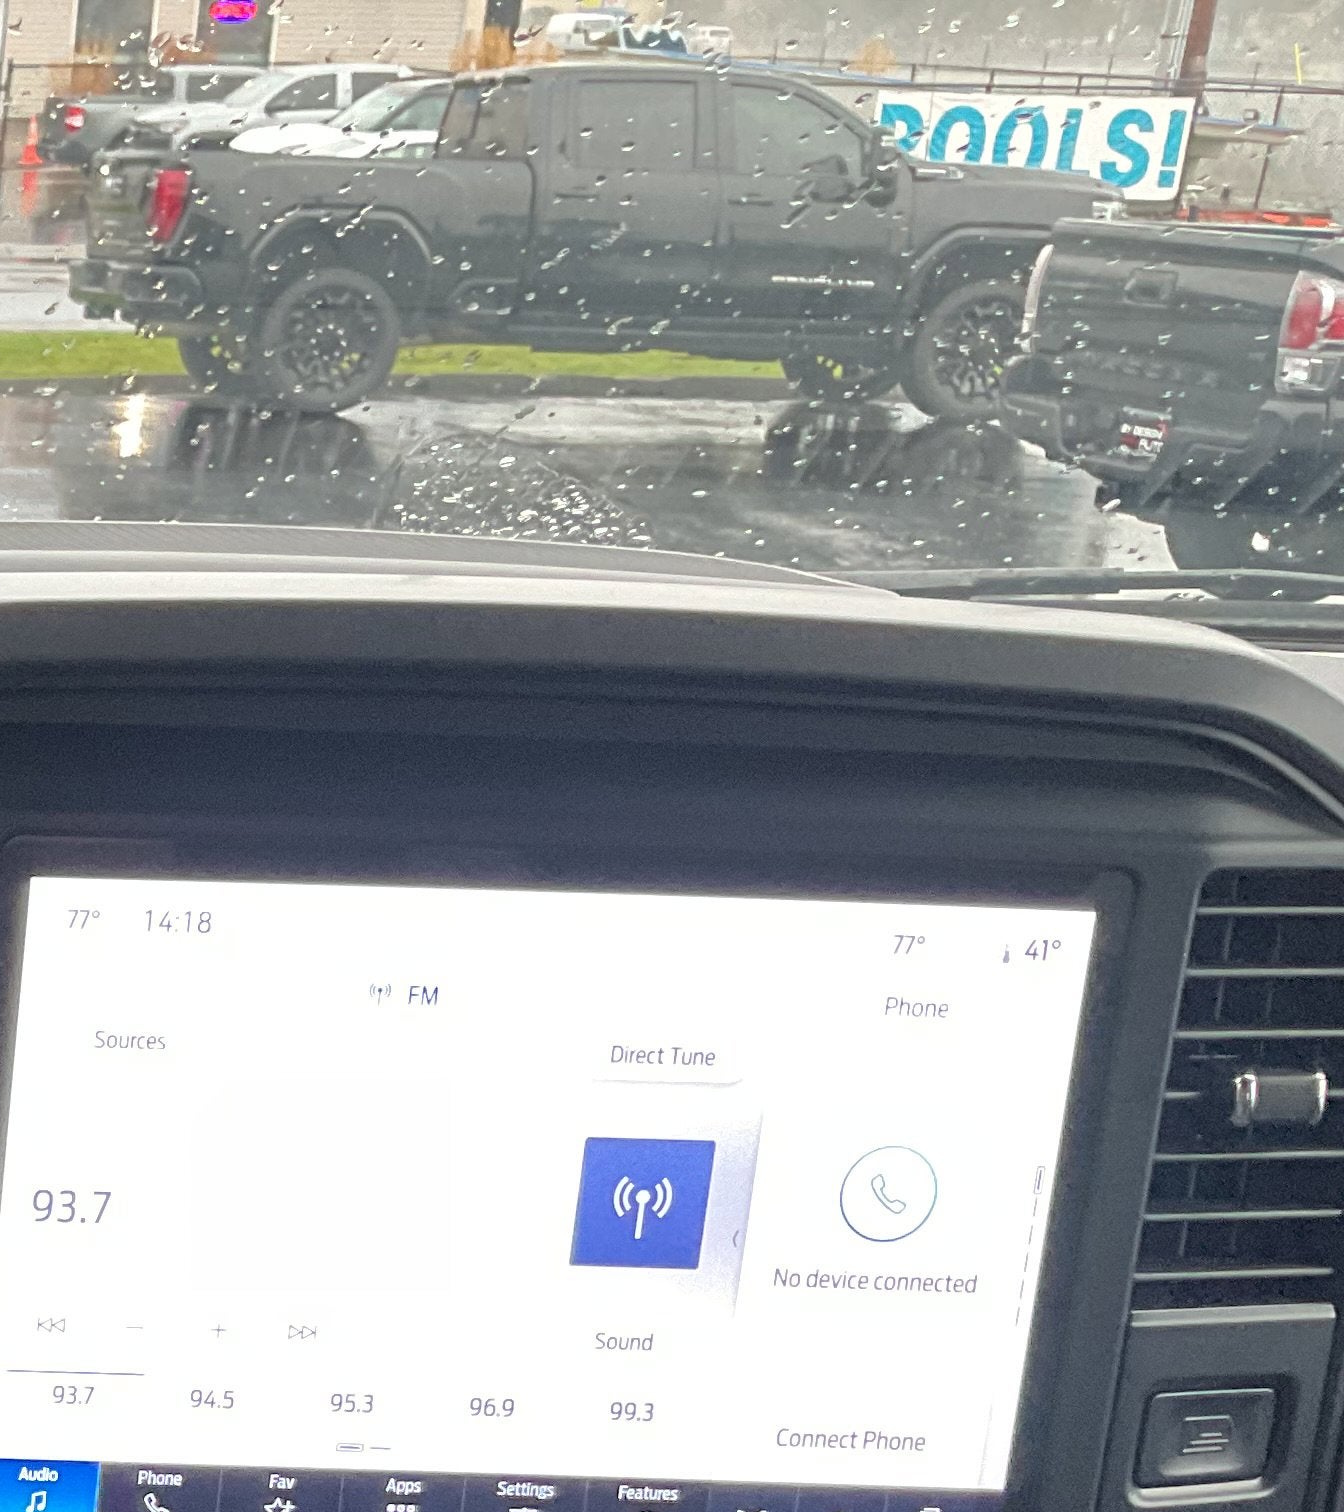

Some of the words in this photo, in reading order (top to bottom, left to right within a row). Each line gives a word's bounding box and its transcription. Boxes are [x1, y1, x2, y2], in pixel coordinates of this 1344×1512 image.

[145, 909, 212, 934] 14:18
[1024, 939, 1062, 961] 41°
[408, 985, 439, 1005] FM
[884, 996, 949, 1019] Phone
[95, 1030, 166, 1050] Sources
[610, 1045, 665, 1065] Direct
[671, 1046, 716, 1066] Tune
[32, 1189, 112, 1224] 93.7
[773, 1268, 801, 1288] No
[806, 1269, 869, 1290] device
[873, 1274, 978, 1294] connected
[595, 1332, 654, 1351] Sound
[52, 1385, 95, 1405] 93.7
[190, 1389, 234, 1409] 94.5
[330, 1393, 374, 1414] 95.3
[469, 1397, 515, 1418] 96.9
[610, 1401, 654, 1422] 99.3
[776, 1428, 858, 1449] Connect
[862, 1430, 926, 1452] Phone
[17, 1466, 59, 1482] Audio
[137, 1469, 183, 1487] Phone
[268, 1473, 296, 1490] Fav
[385, 1477, 422, 1496] Apps
[496, 1480, 555, 1501] Settings
[617, 1484, 679, 1502] Features
